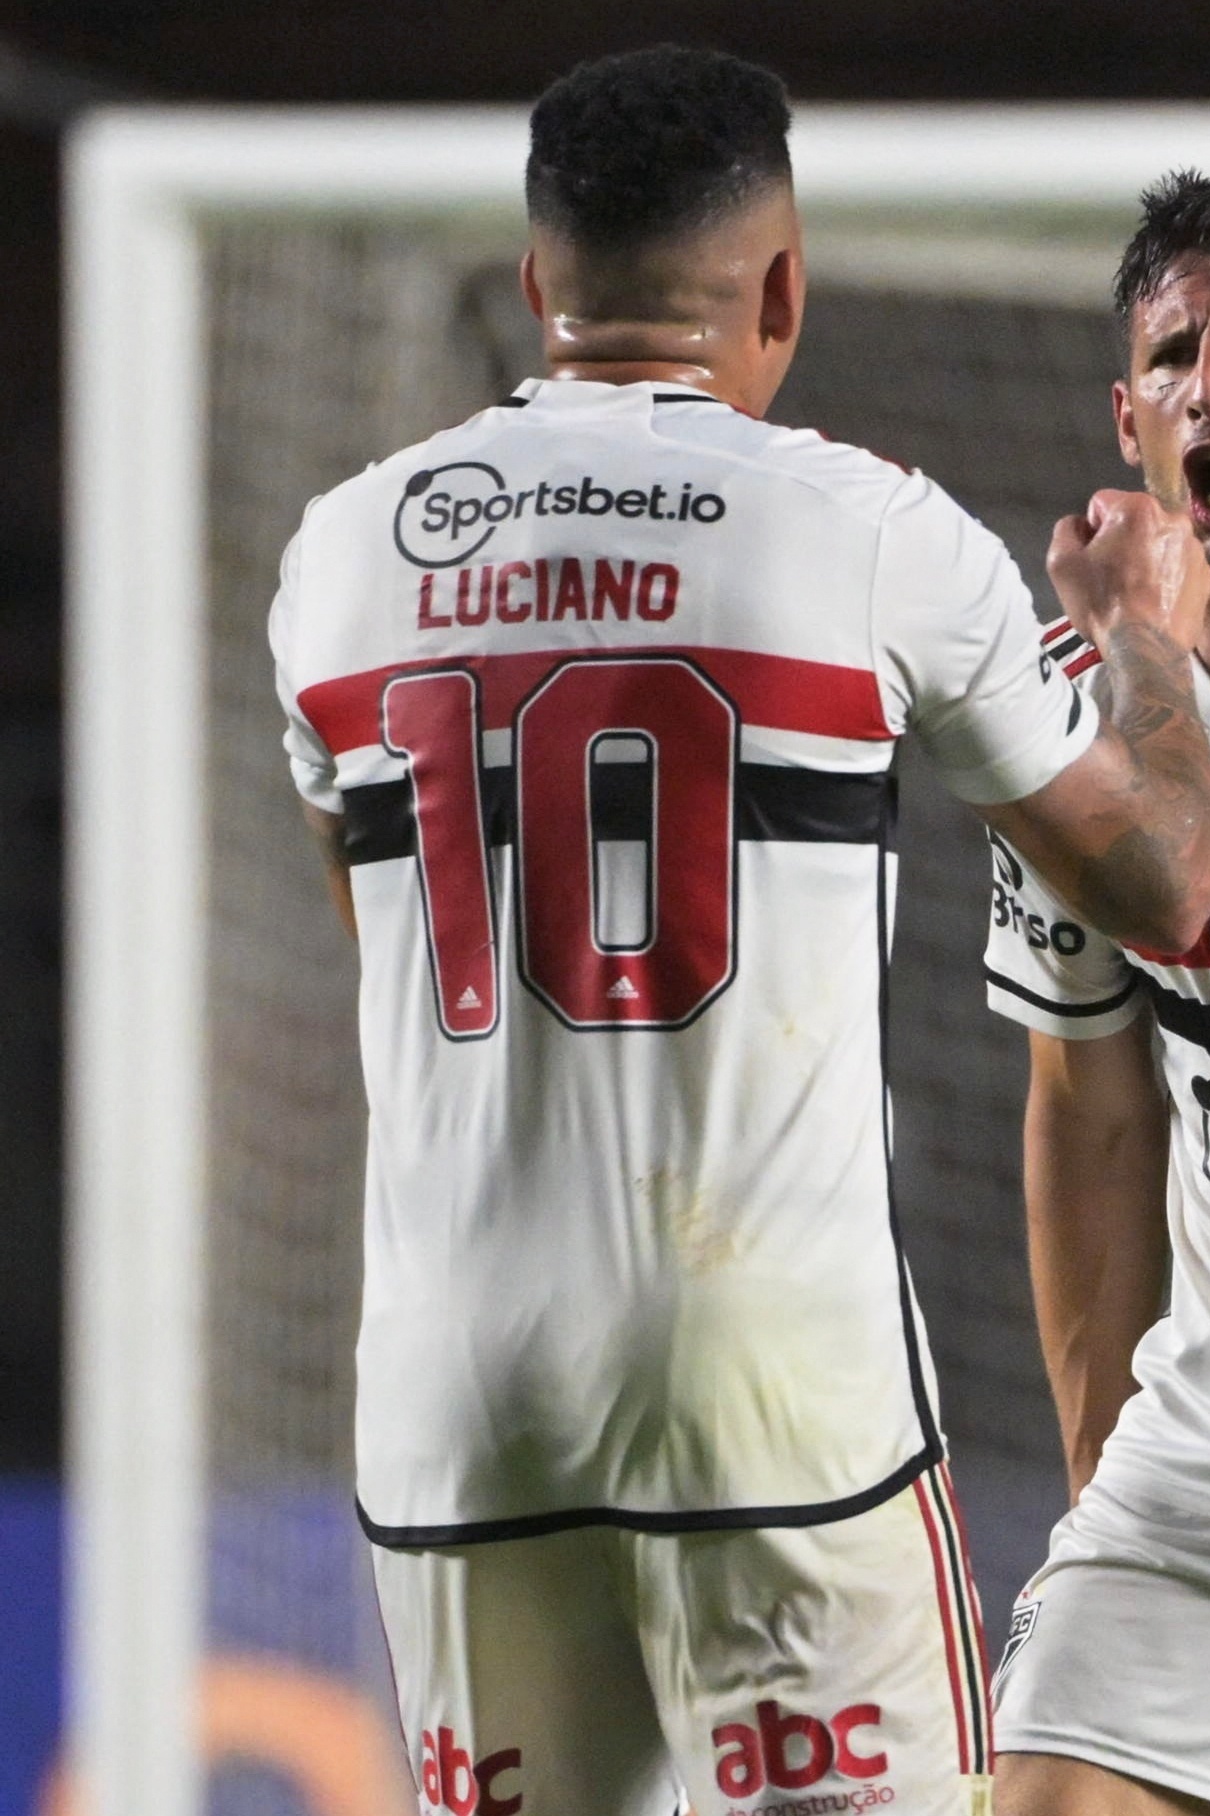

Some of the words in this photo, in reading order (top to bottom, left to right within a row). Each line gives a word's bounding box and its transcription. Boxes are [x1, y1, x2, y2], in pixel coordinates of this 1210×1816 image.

[421, 476, 726, 541] Sportsbet.io
[417, 557, 680, 630] LUCIANO
[379, 653, 742, 1042] 10
[422, 1725, 524, 1816] abc
[711, 1699, 889, 1799] abc
[751, 1783, 895, 1816] construção
